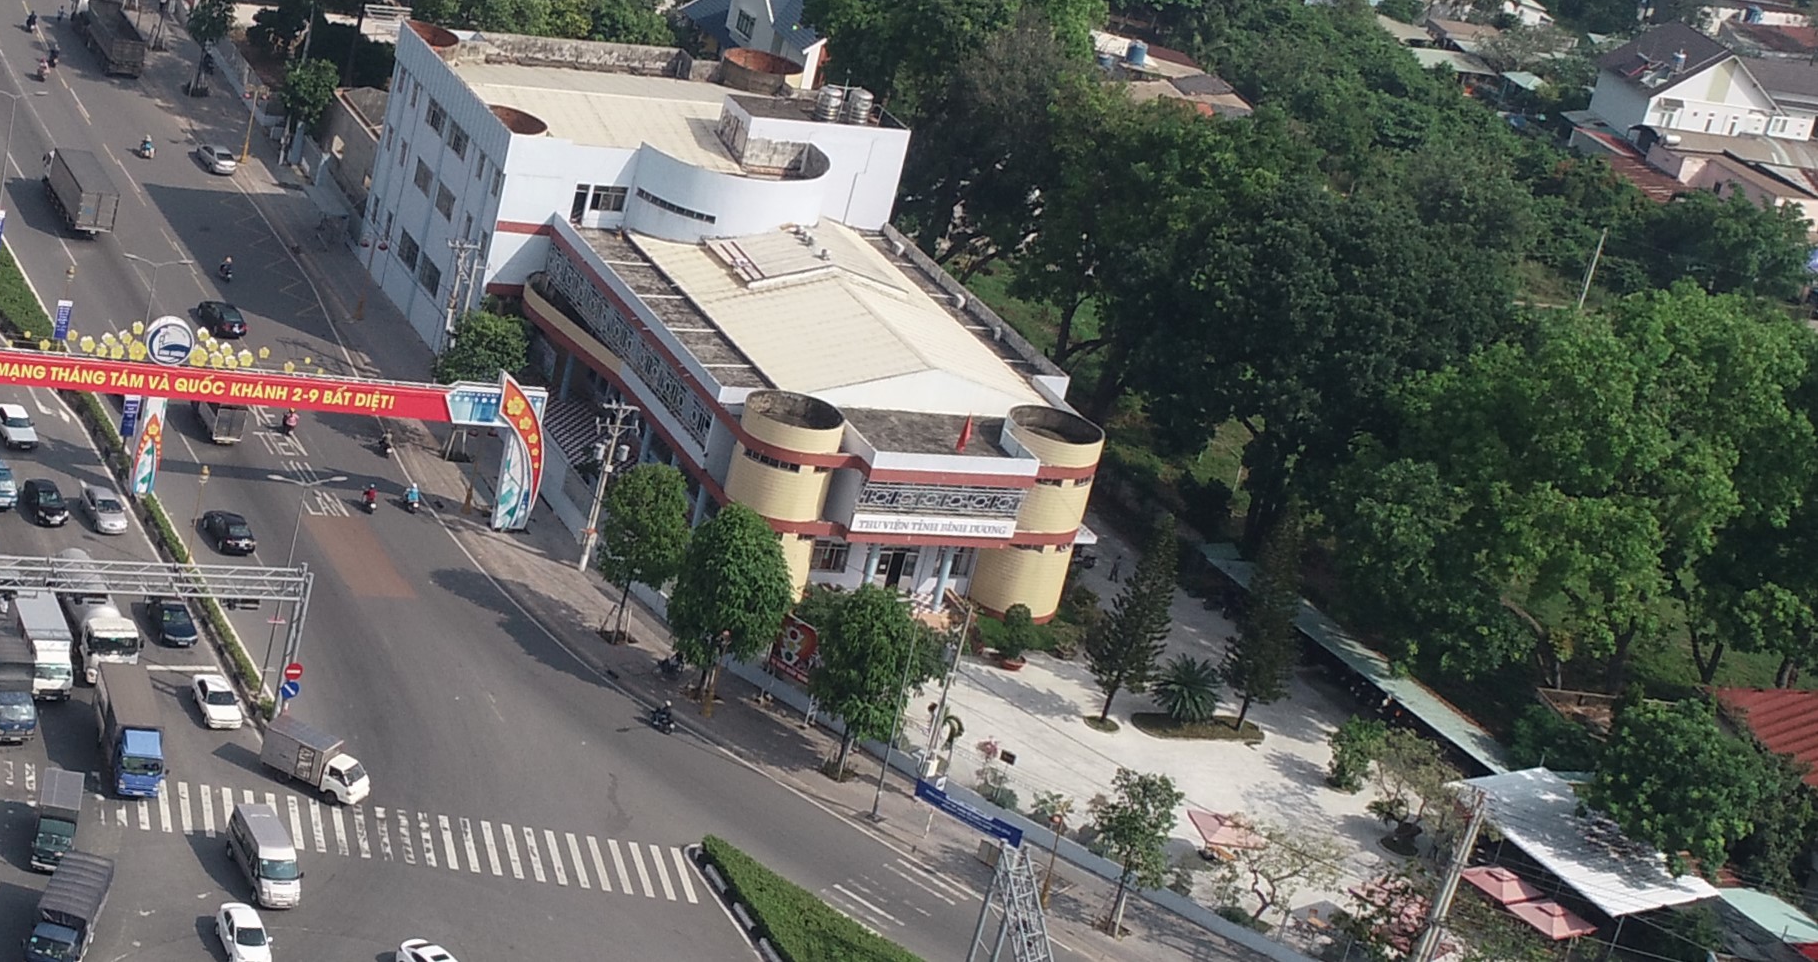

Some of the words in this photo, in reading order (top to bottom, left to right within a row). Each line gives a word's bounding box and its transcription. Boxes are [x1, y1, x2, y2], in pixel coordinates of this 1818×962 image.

[49, 363, 107, 386] THÁNG
[110, 367, 144, 389] TÁM
[148, 370, 171, 391] VÀ
[174, 373, 225, 396] QUỐC
[229, 380, 289, 401] KHÁNH
[292, 388, 319, 403] 2-9
[323, 384, 353, 406] BẤT
[354, 391, 395, 412] DIỆT!
[882, 519, 909, 532] VIỆN
[940, 521, 967, 533] BÌNH
